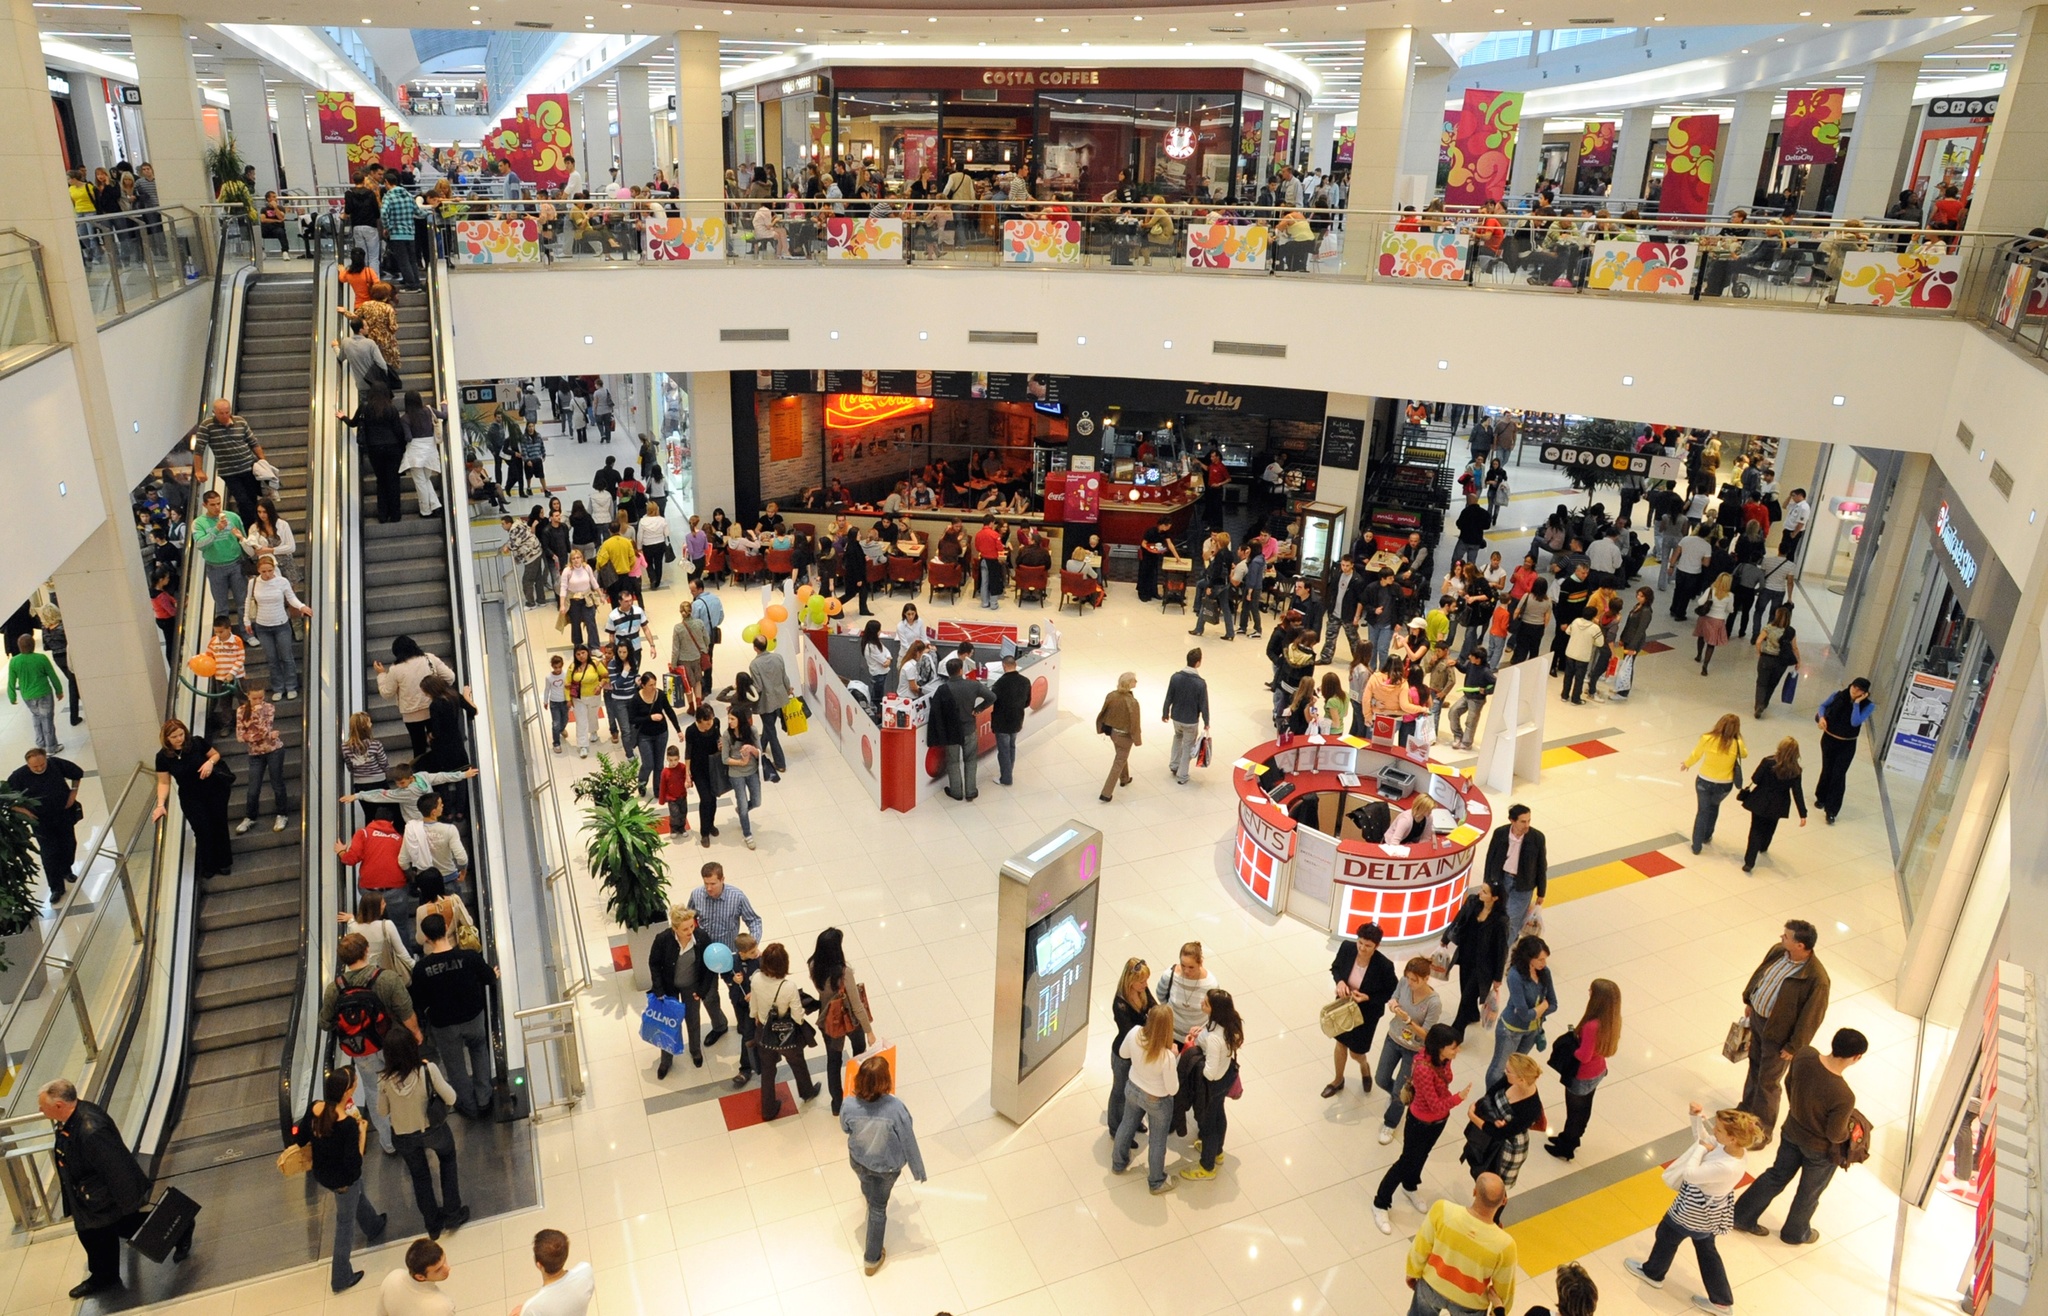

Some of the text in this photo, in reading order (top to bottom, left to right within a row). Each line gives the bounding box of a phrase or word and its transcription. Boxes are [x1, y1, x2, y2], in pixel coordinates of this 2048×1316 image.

[983, 71, 1099, 86] COSTA COFFEE
[1185, 389, 1242, 410] Trolly
[1344, 858, 1432, 881] DELTA
[425, 959, 464, 977] REPLAY
